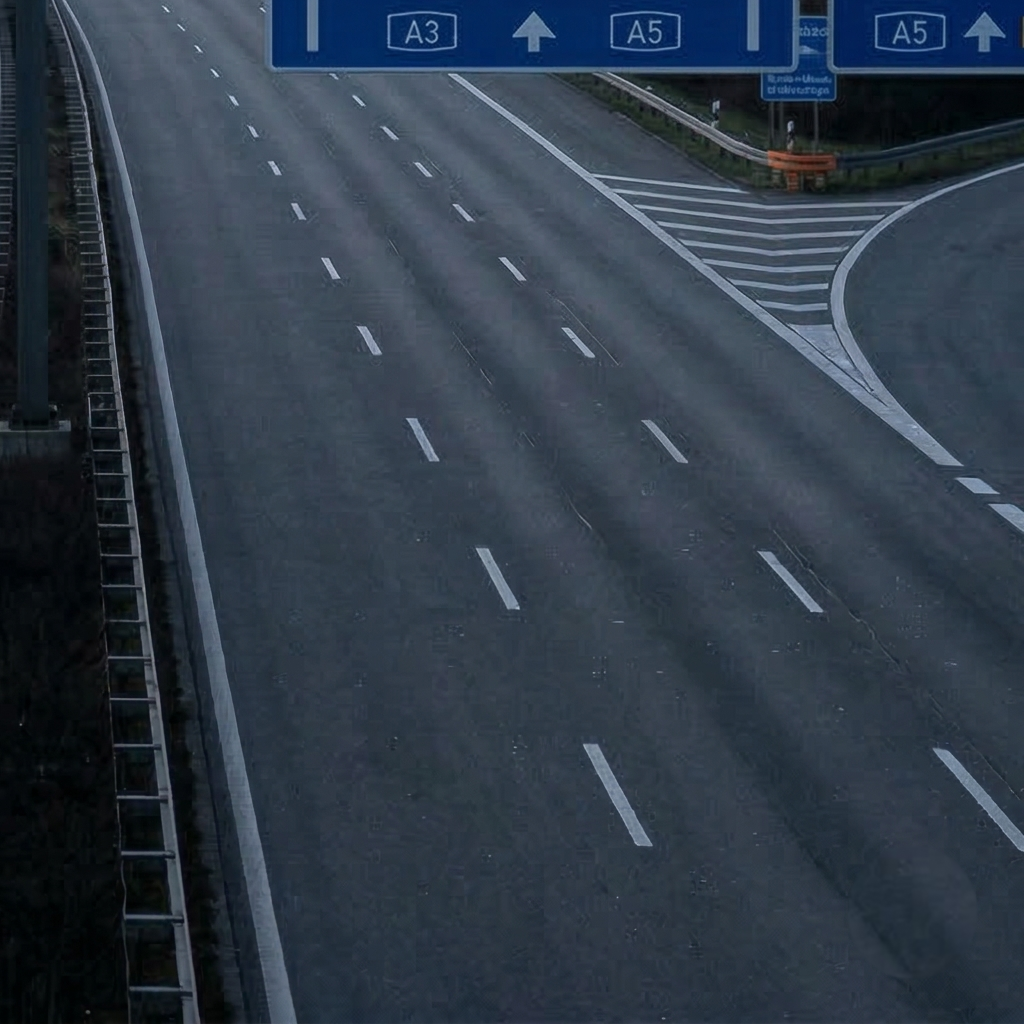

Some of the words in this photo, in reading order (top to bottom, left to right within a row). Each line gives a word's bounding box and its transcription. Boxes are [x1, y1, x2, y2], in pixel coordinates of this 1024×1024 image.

[405, 20, 439, 44] A3
[627, 20, 663, 44] A5
[892, 20, 927, 45] A5
